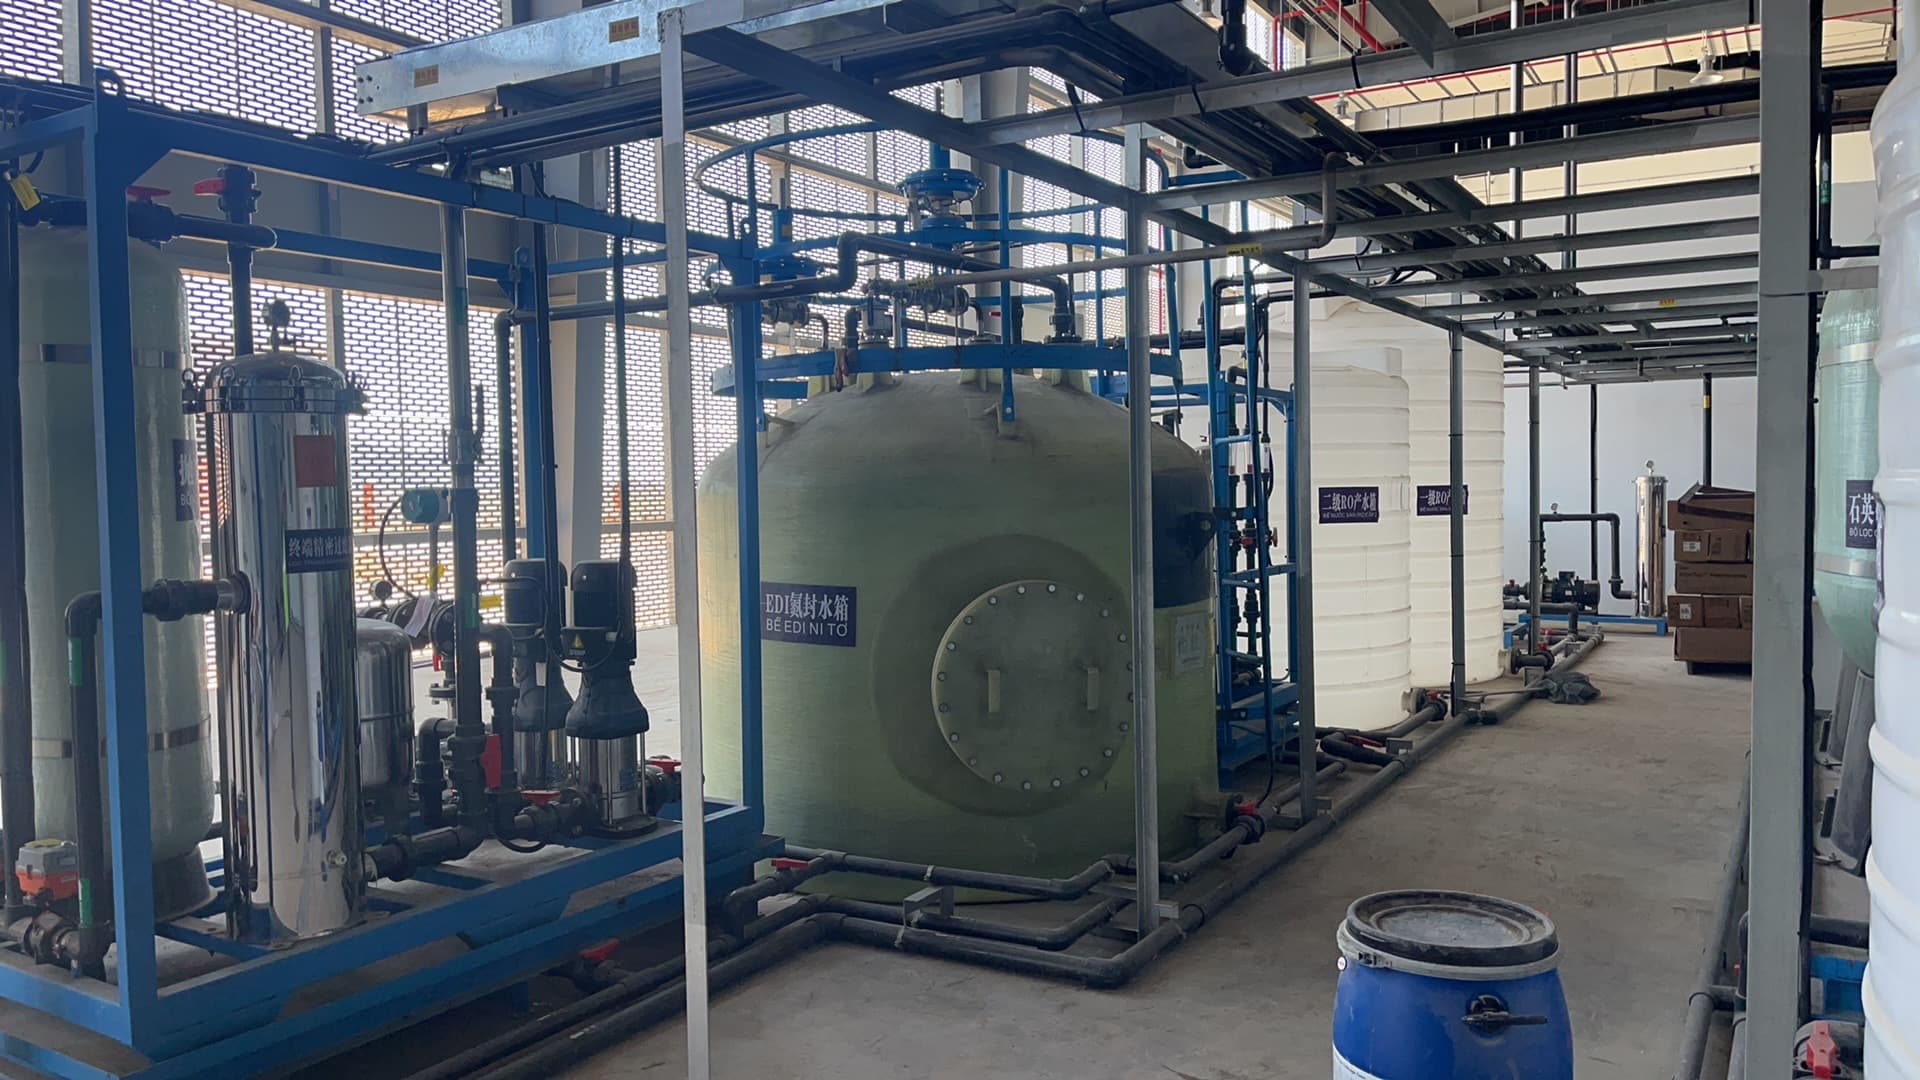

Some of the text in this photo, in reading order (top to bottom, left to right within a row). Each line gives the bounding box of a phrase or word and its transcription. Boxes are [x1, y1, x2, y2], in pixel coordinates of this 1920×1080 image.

[1321, 491, 1376, 511] 二级RO产水箱
[765, 592, 849, 621] EDI氮封水箱
[784, 620, 806, 634] EDI
[809, 621, 823, 635] NI
